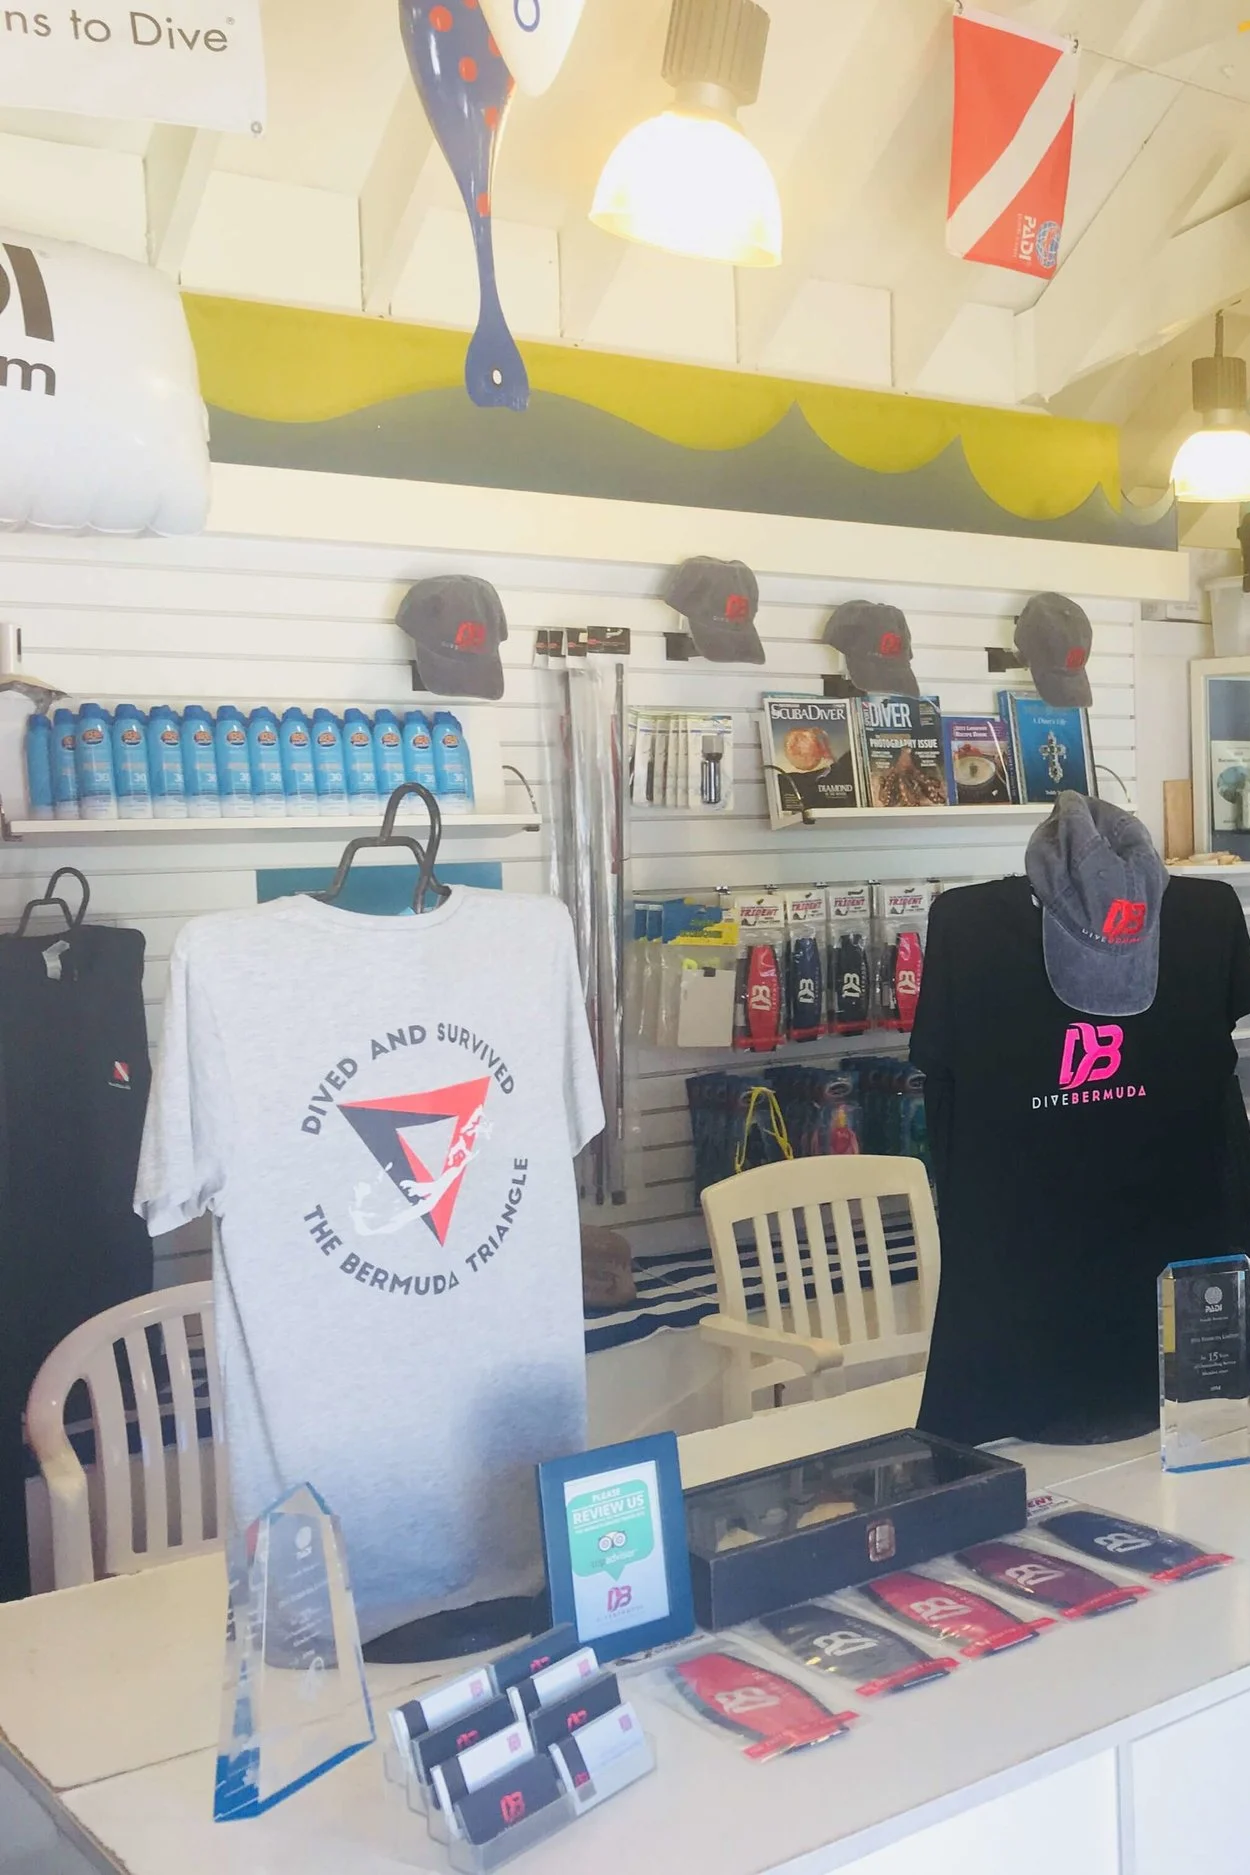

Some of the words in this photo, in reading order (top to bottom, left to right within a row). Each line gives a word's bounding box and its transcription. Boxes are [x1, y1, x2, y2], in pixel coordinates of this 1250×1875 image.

[70, 9, 112, 43] to
[870, 702, 912, 728] DIVER
[918, 738, 938, 749] ISSUE
[301, 1057, 358, 1135] DIVED
[370, 1024, 427, 1060] AND
[437, 1022, 515, 1095] SURVIVED
[303, 1204, 343, 1256] THE
[339, 1252, 460, 1296] BERMUDA
[465, 1158, 528, 1272] TRIANGLE
[572, 1499, 624, 1525] REVIEW
[626, 1494, 645, 1509] US
[592, 1488, 621, 1502] PLEASE
